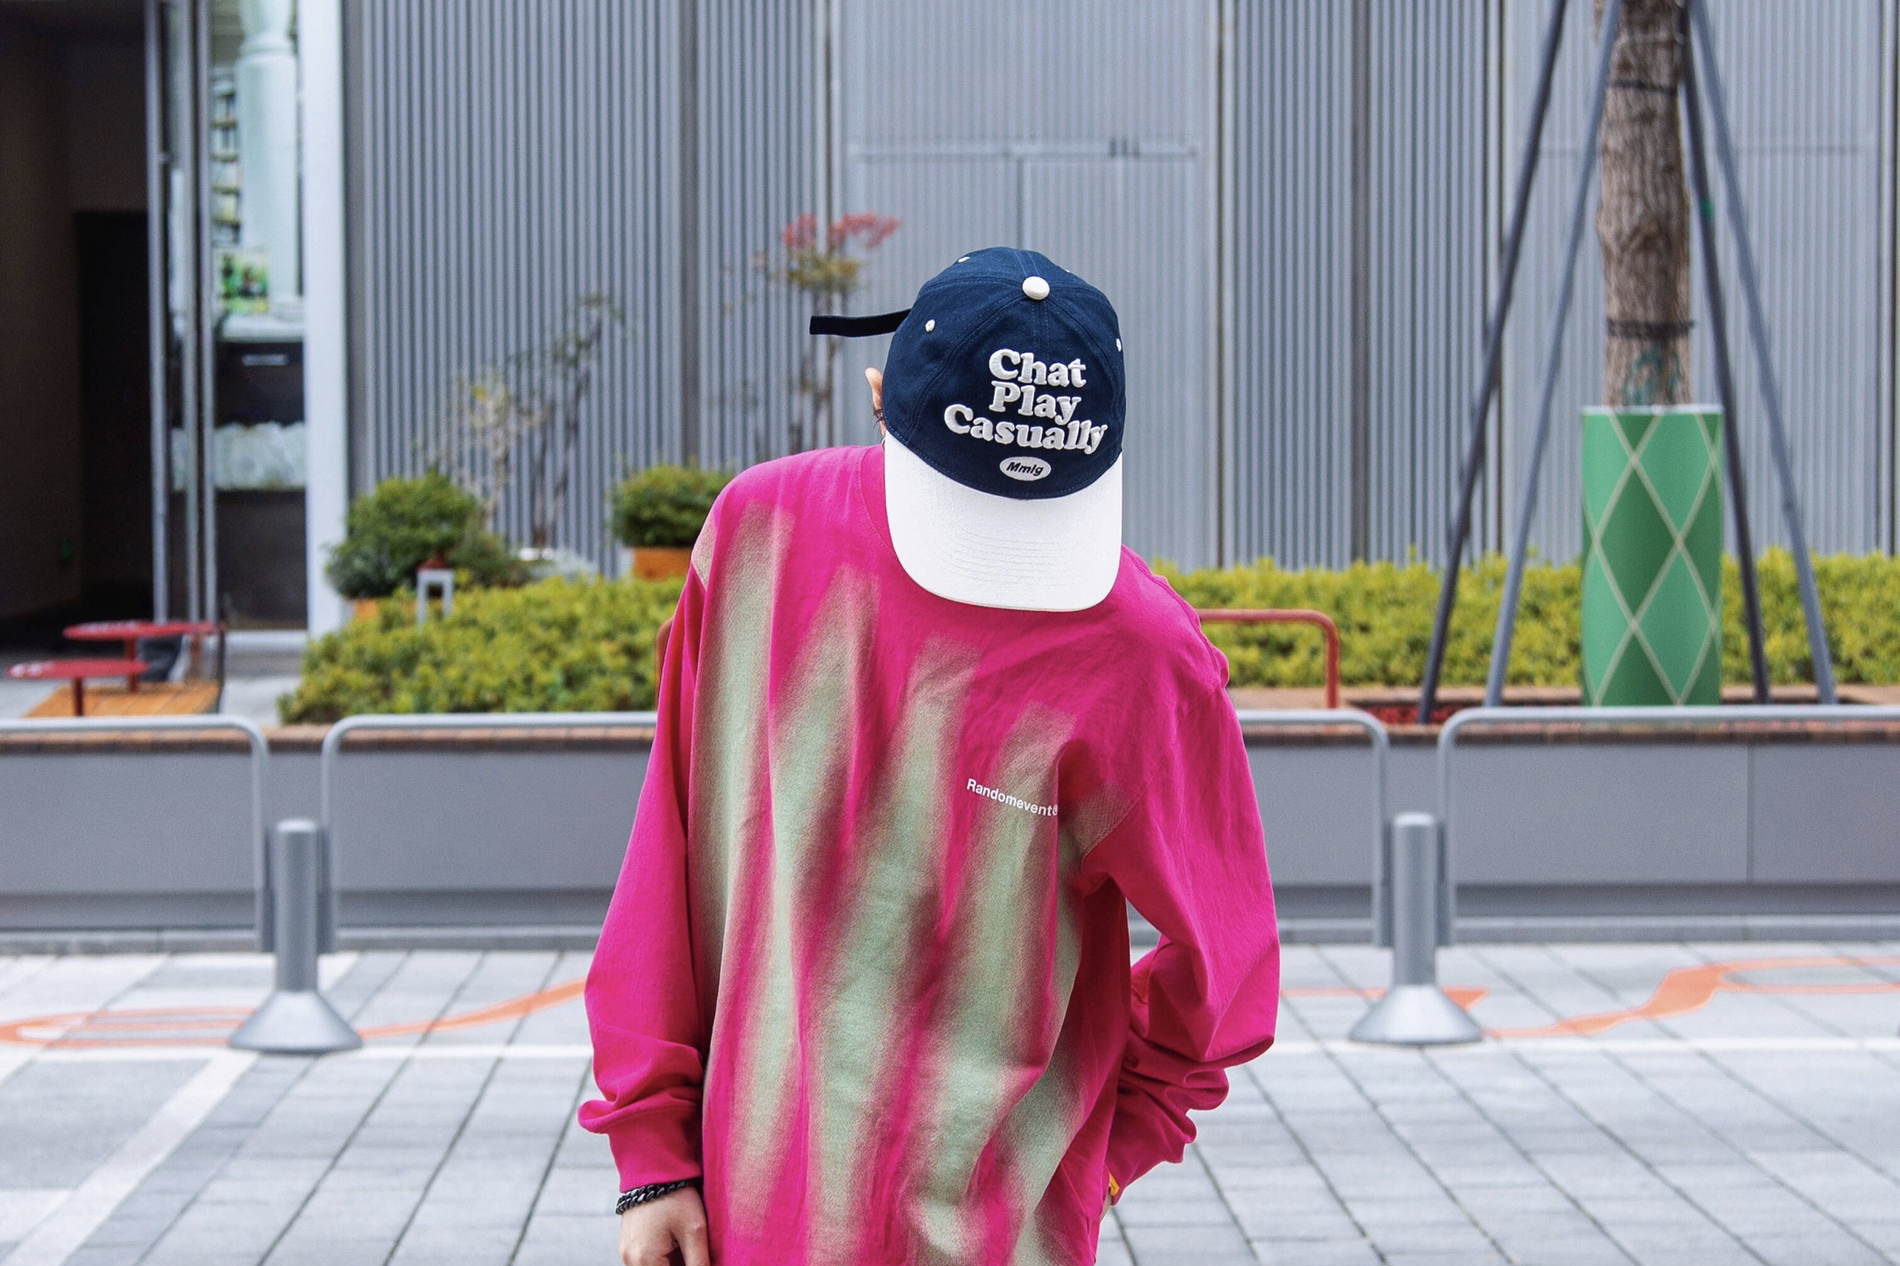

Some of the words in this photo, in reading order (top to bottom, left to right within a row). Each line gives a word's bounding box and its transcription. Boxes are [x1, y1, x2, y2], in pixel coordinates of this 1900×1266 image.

[989, 348, 1087, 388] Chat
[988, 380, 1082, 426] Play
[943, 403, 1109, 455] Casually
